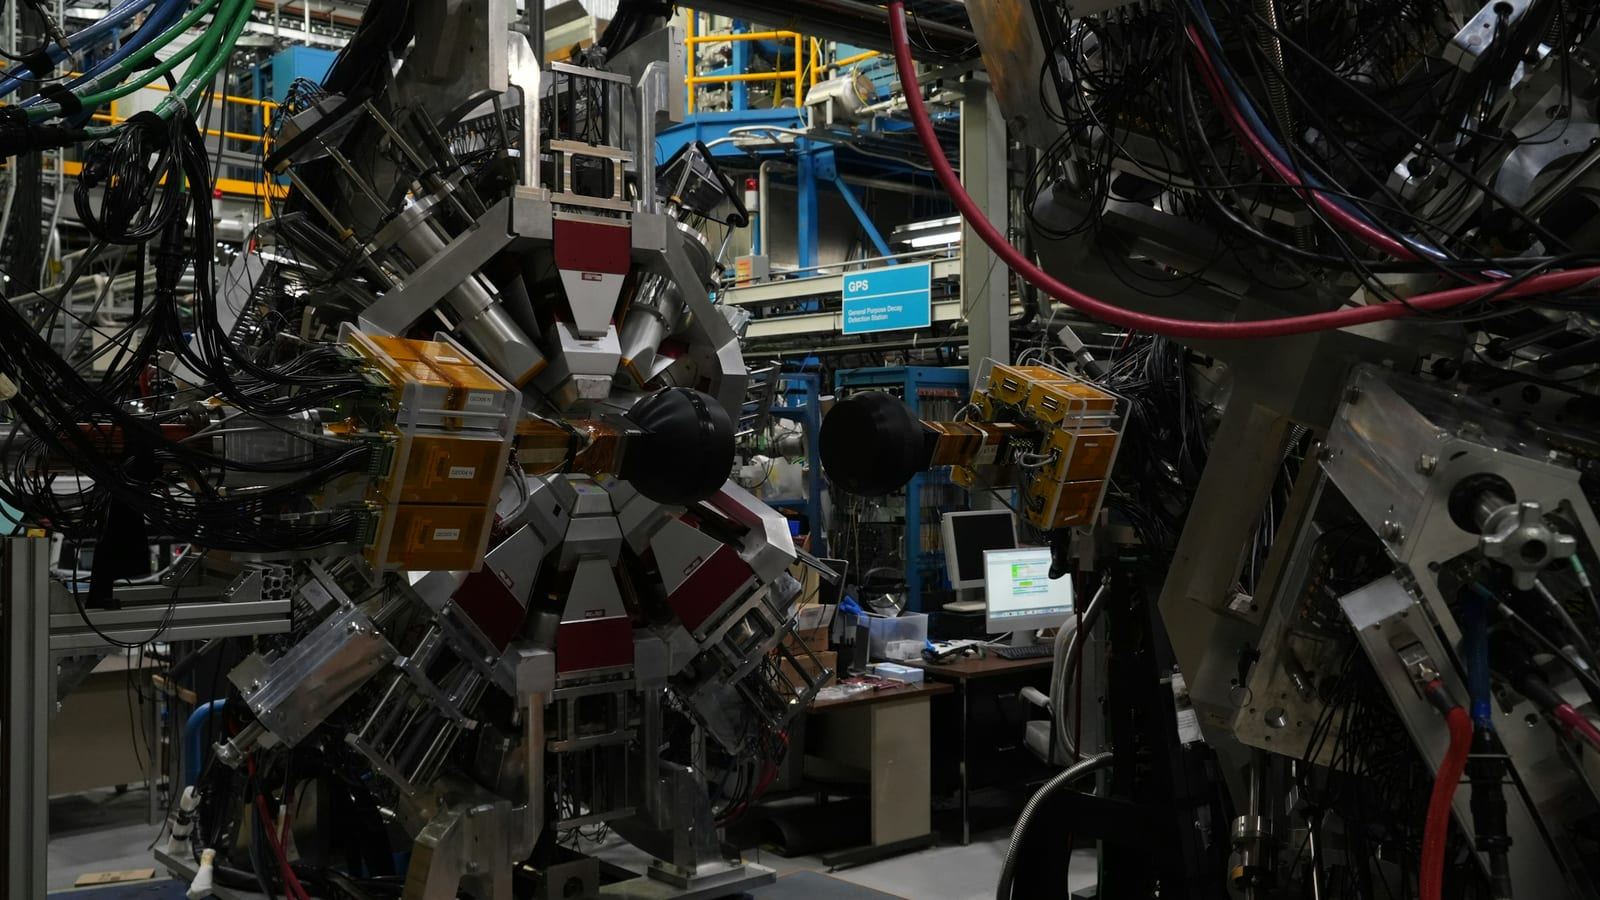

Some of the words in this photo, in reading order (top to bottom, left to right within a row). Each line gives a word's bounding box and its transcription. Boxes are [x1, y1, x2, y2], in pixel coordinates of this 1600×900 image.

[848, 279, 869, 292] GPS
[848, 308, 866, 316] General
[867, 306, 886, 315] Purpose
